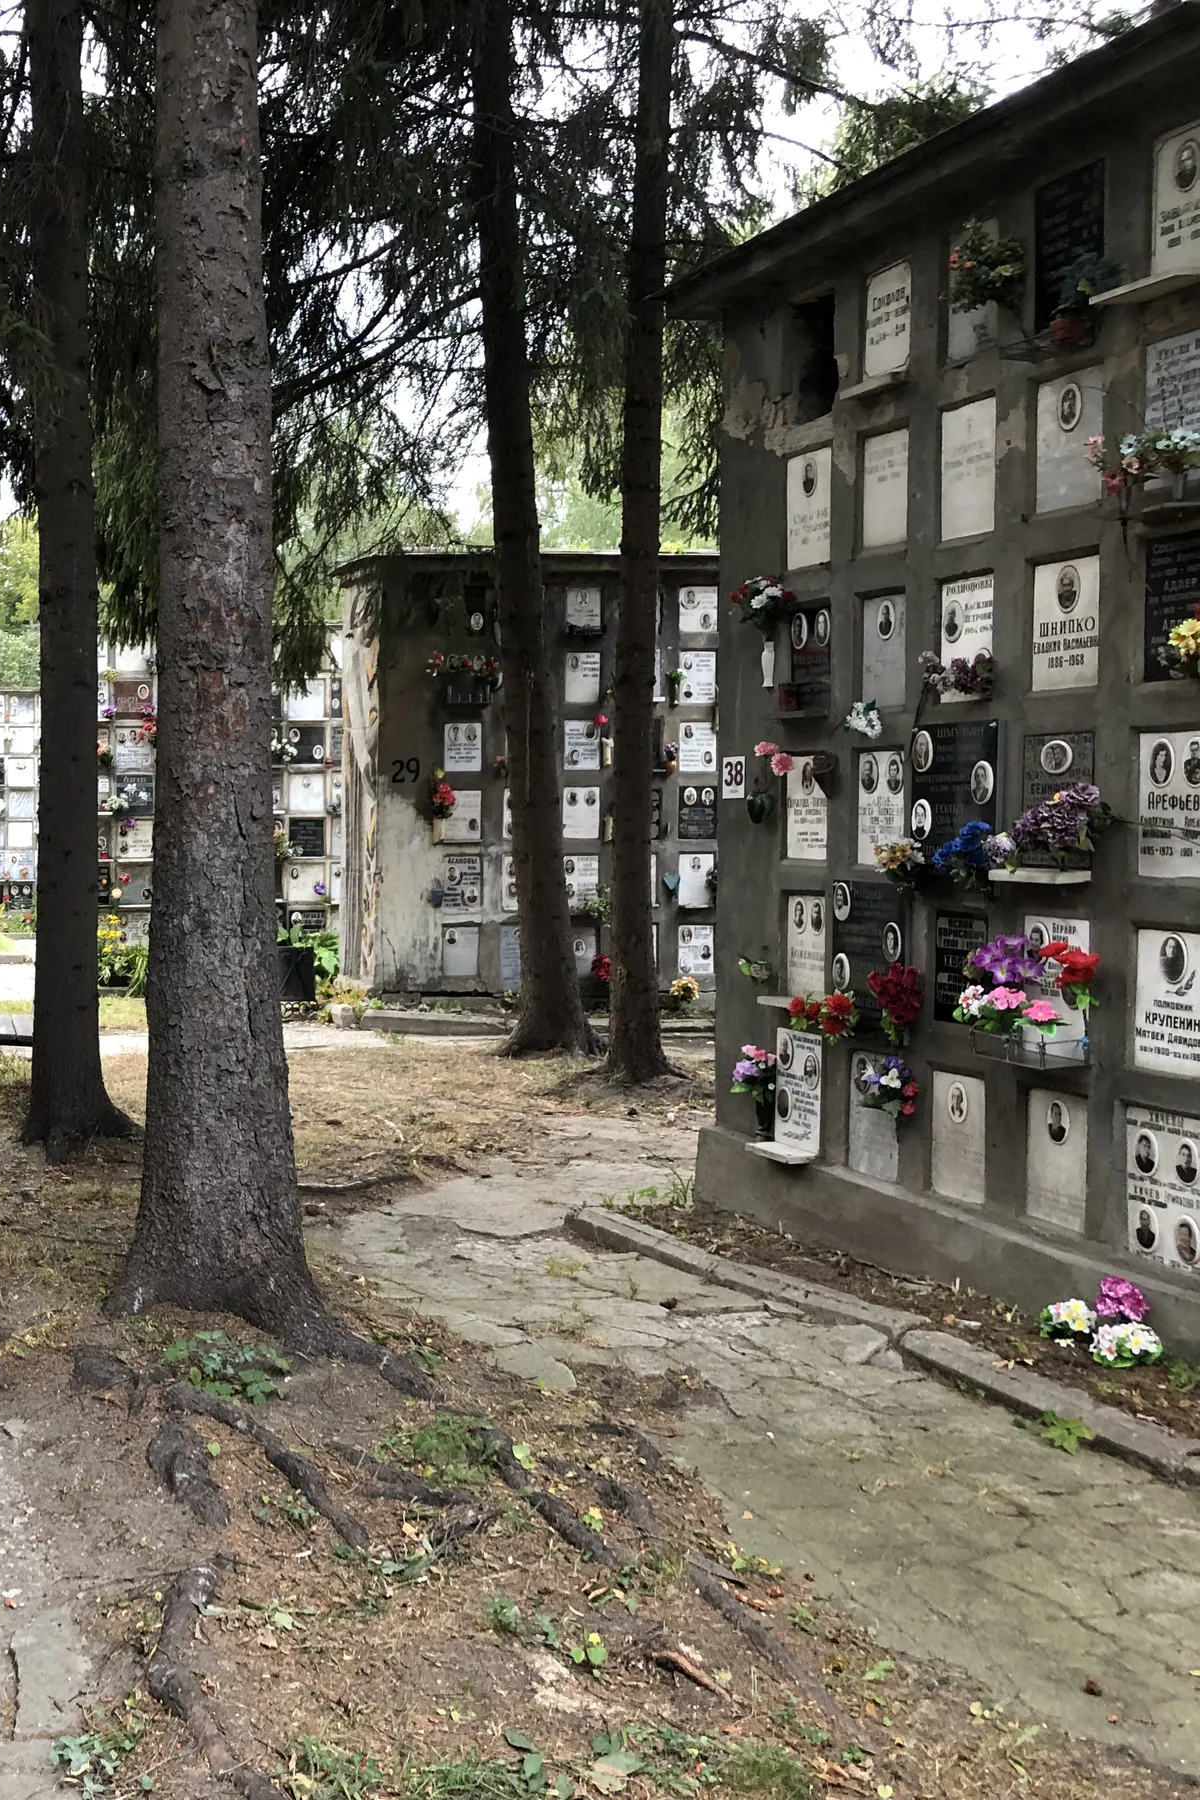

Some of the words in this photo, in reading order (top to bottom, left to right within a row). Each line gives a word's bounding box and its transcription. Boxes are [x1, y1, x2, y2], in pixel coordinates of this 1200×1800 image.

[946, 578, 993, 597] РОДИОНОВЫ
[1039, 615, 1096, 639] ШНИПКО
[1033, 639, 1061, 656] ЕВДОКИЯ
[391, 756, 421, 784] 29
[723, 760, 744, 787] 38
[1153, 999, 1194, 1014] ПОЛКОВНИК
